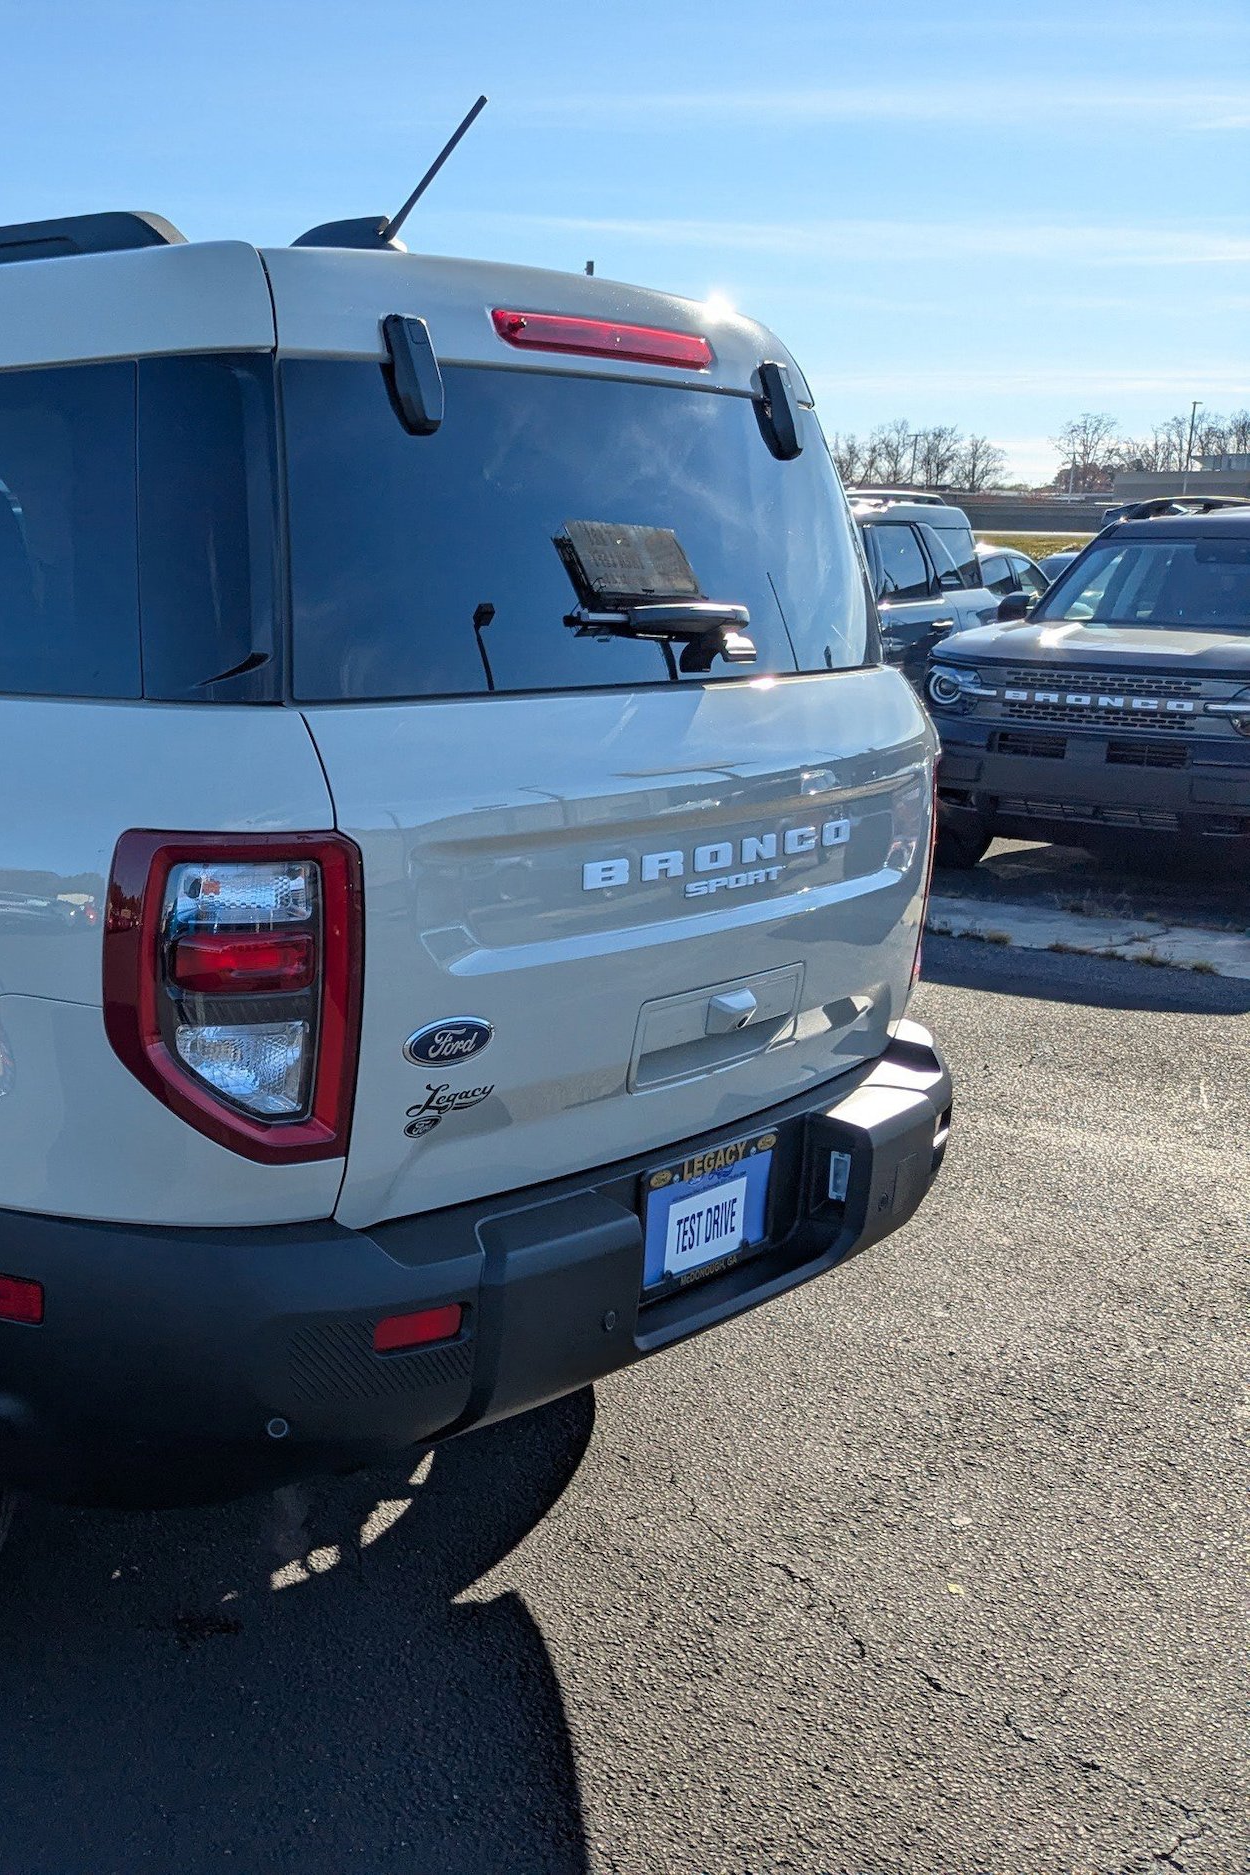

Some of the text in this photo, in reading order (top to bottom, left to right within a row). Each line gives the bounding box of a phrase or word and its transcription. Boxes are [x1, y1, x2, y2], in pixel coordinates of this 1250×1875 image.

[1004, 689, 1196, 712] BRONCO
[582, 818, 851, 891] BRONCO
[684, 865, 787, 898] SPORT
[427, 1027, 479, 1058] Ford
[405, 1083, 495, 1118] Legacy
[682, 1140, 747, 1181] LEGACY
[676, 1197, 738, 1255] TEST DRIVE
